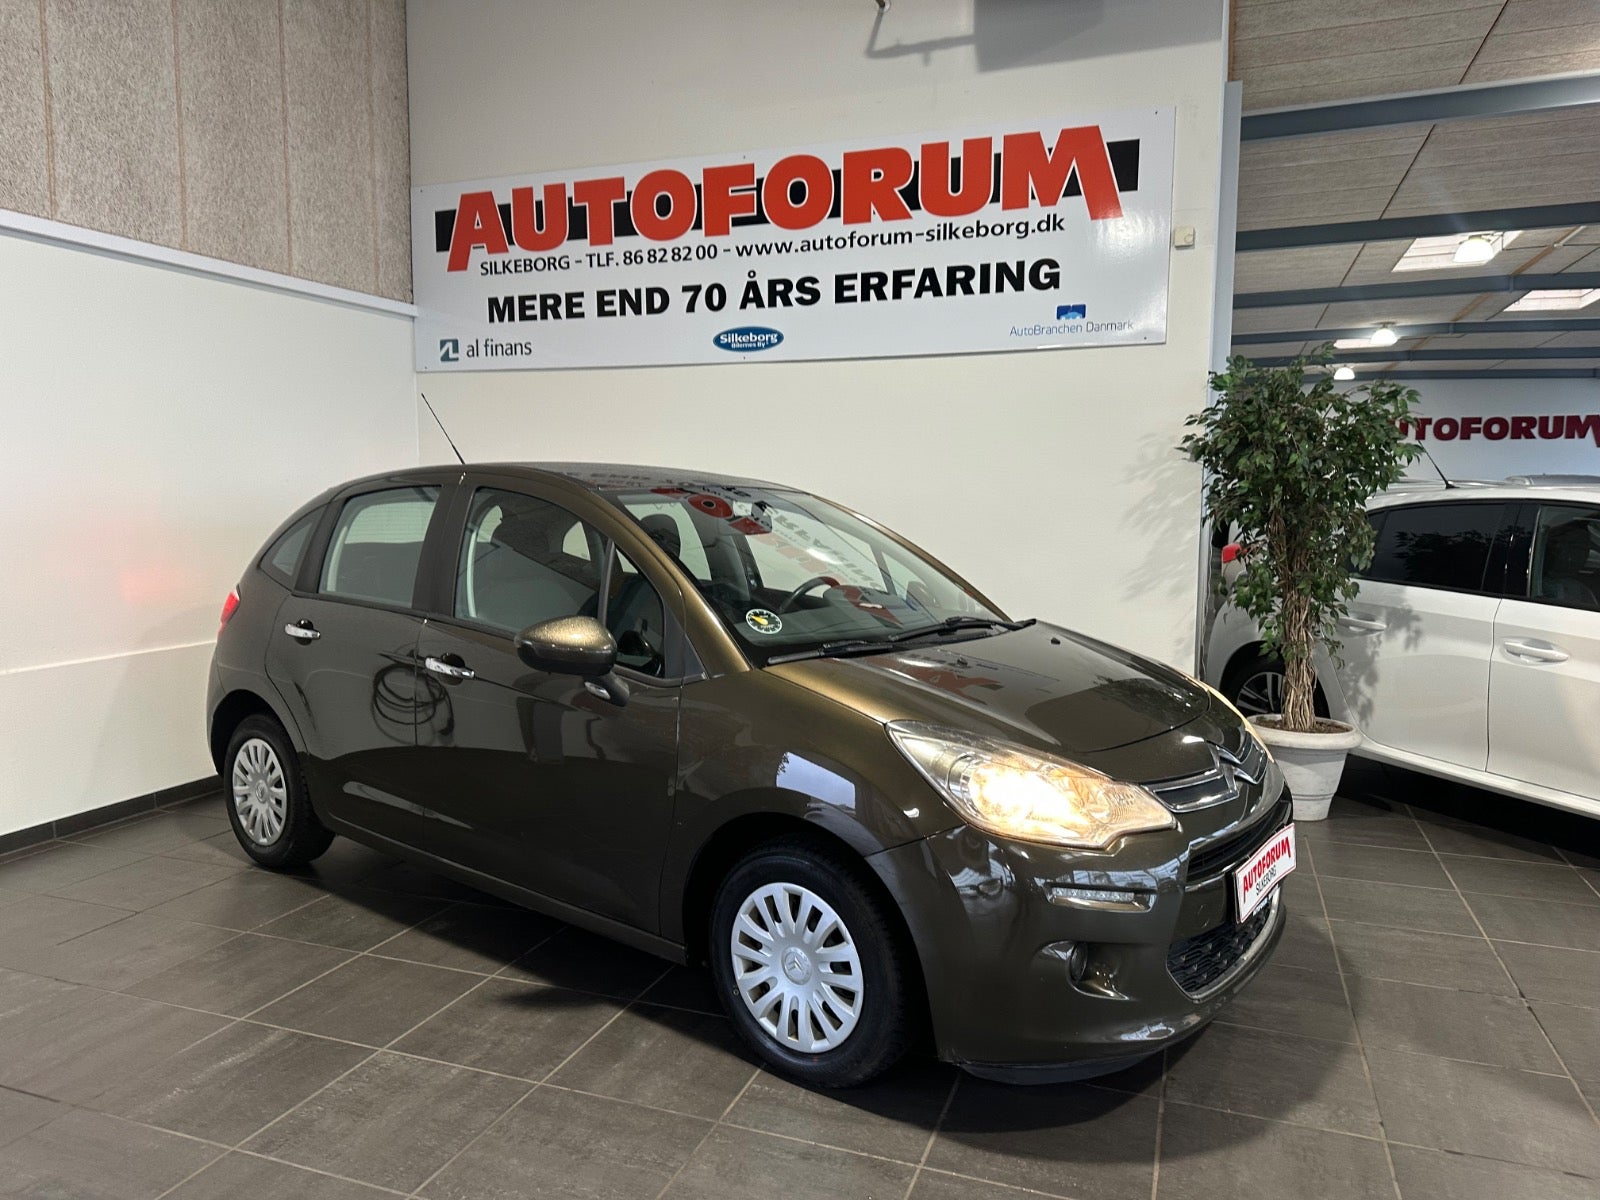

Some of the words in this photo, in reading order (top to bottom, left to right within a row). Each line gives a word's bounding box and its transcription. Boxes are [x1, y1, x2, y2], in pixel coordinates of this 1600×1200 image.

[447, 124, 1123, 272] AUTOFORUM
[480, 254, 570, 276] SILKEBORG
[586, 252, 619, 269] TLF.
[735, 213, 1065, 257] www.autoforum-silkeborg.dk
[487, 291, 585, 324] MERE
[596, 286, 670, 318] END
[681, 282, 727, 313] 70
[739, 270, 821, 309] ÅRS
[834, 257, 1061, 304] ERFARING
[720, 332, 778, 344] Silkeborg
[1009, 323, 1082, 337] AutoBranchen
[1086, 320, 1134, 333] Danmark
[466, 338, 479, 358] al
[484, 338, 532, 357] finans
[1386, 414, 1600, 448] TOFORUM
[1243, 836, 1291, 903] AUTOFORUM
[1255, 864, 1277, 896] SILKEBORG
